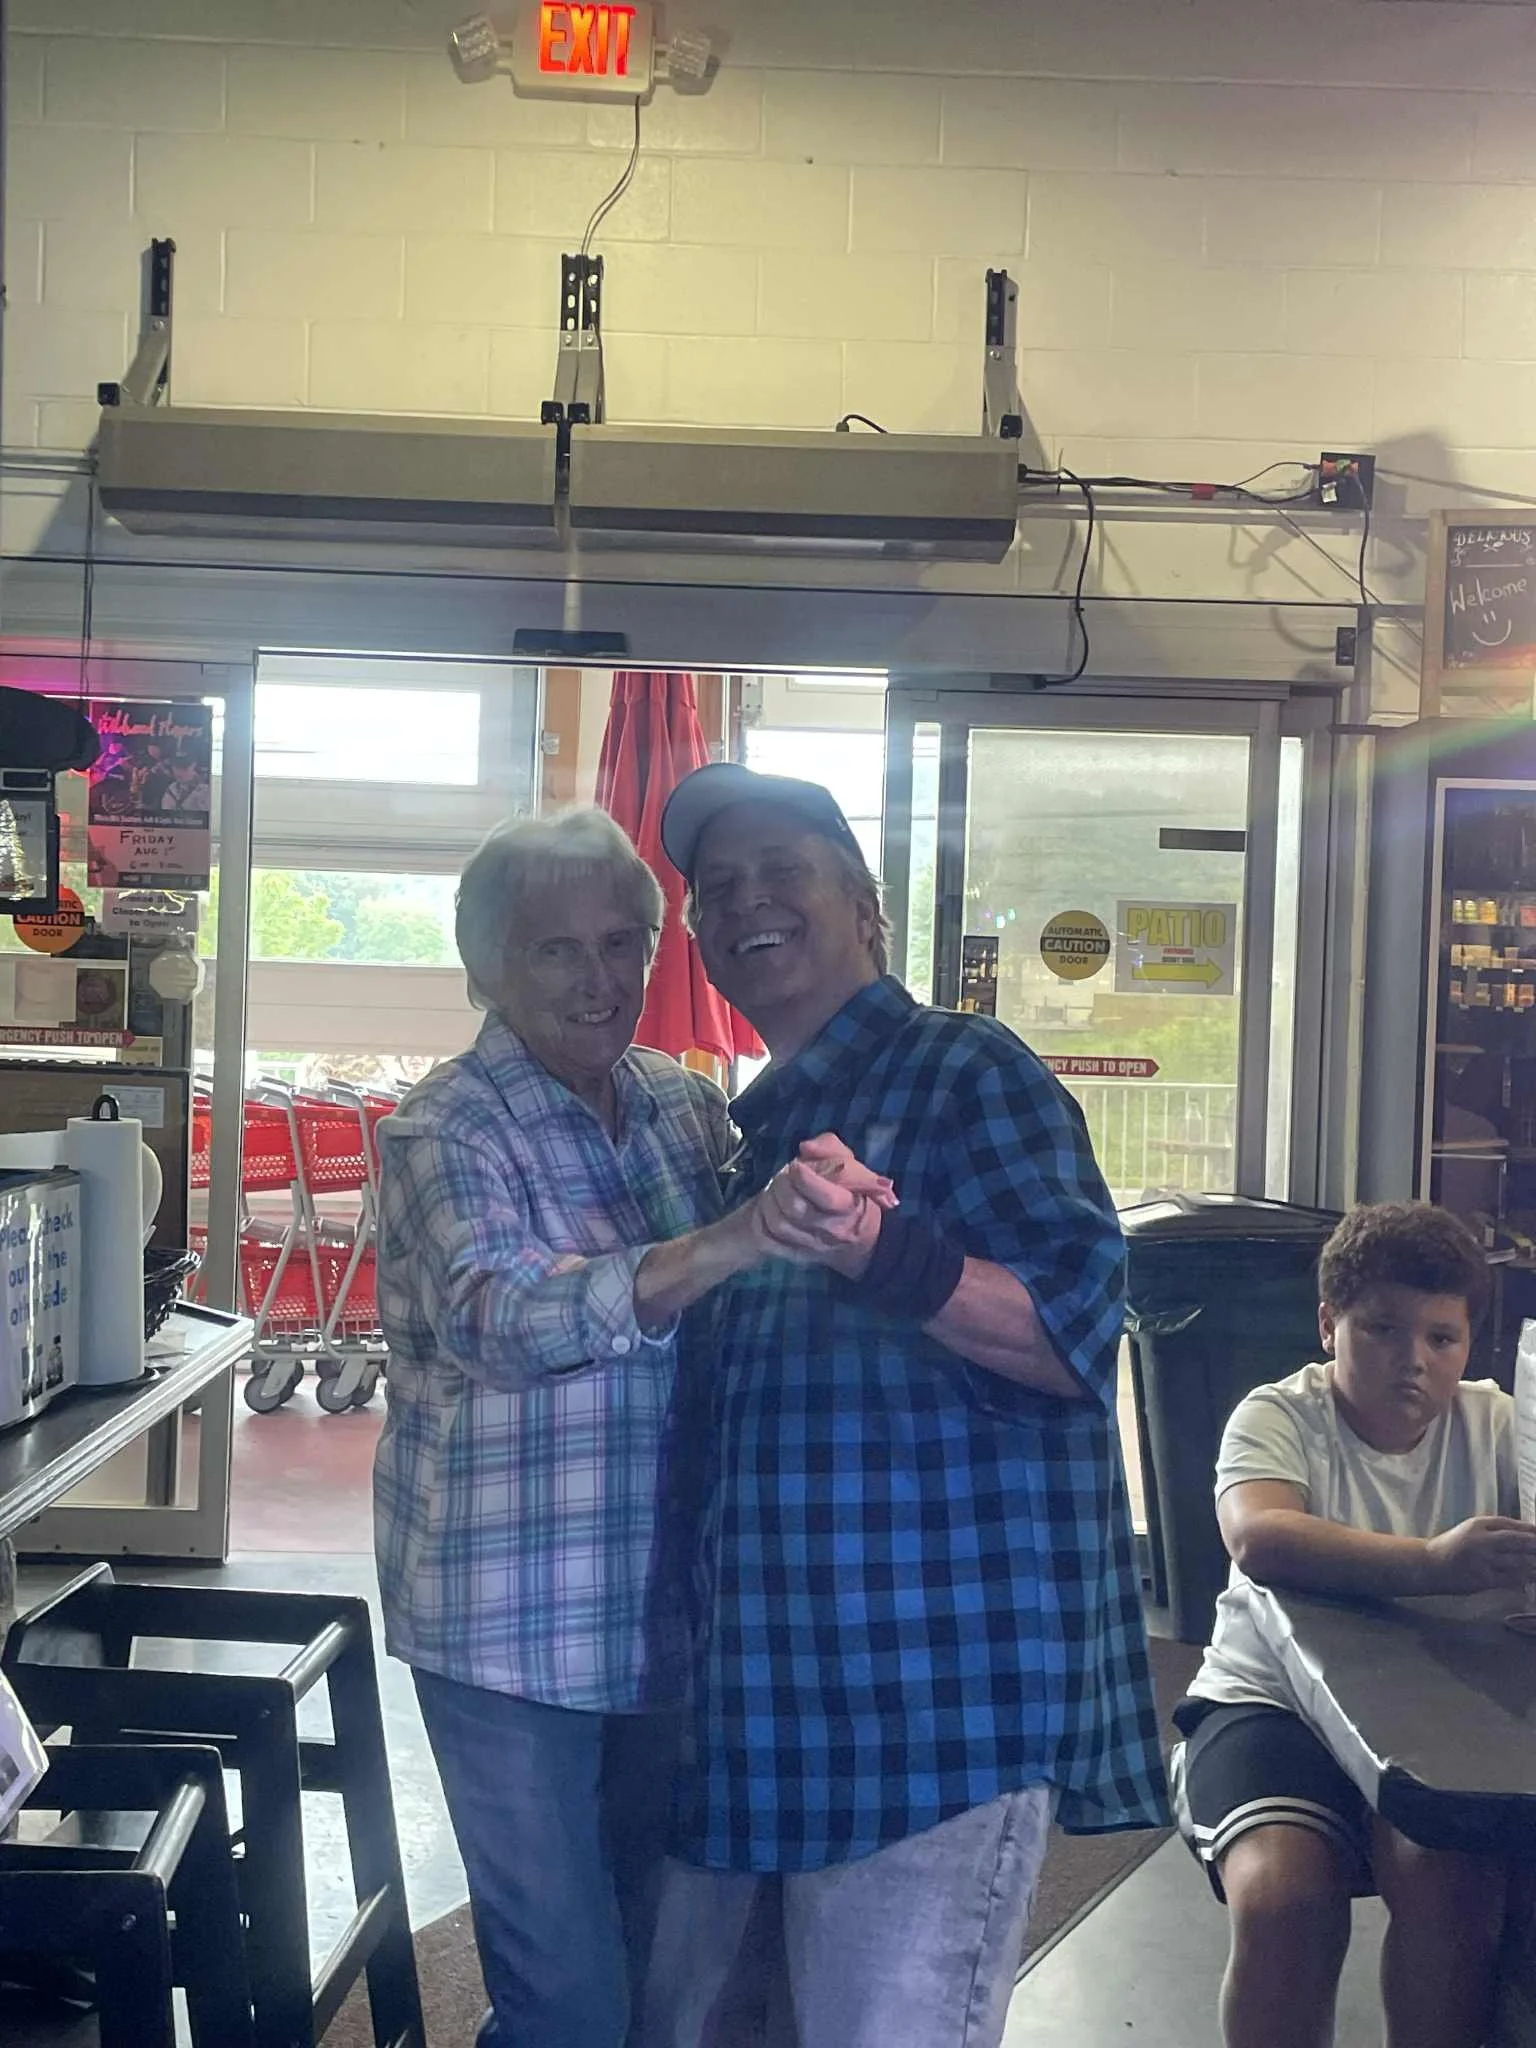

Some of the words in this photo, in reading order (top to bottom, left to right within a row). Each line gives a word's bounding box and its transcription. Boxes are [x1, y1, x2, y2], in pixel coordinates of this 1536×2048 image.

[539, 1, 636, 76] EXIT
[1450, 577, 1528, 616] Welcome
[120, 830, 175, 845] FRIDAY
[134, 847, 159, 856] AUG
[33, 928, 63, 938] DOOR
[1048, 926, 1104, 937] AUTOMATIC
[1127, 907, 1226, 948] PATIO
[1044, 938, 1106, 953] CAUTION
[1059, 956, 1088, 965] DOOR
[45, 1030, 74, 1045] PUSH
[1071, 1059, 1099, 1073] PUSH
[1102, 1060, 1116, 1073] TO
[1119, 1061, 1147, 1075] OPEN
